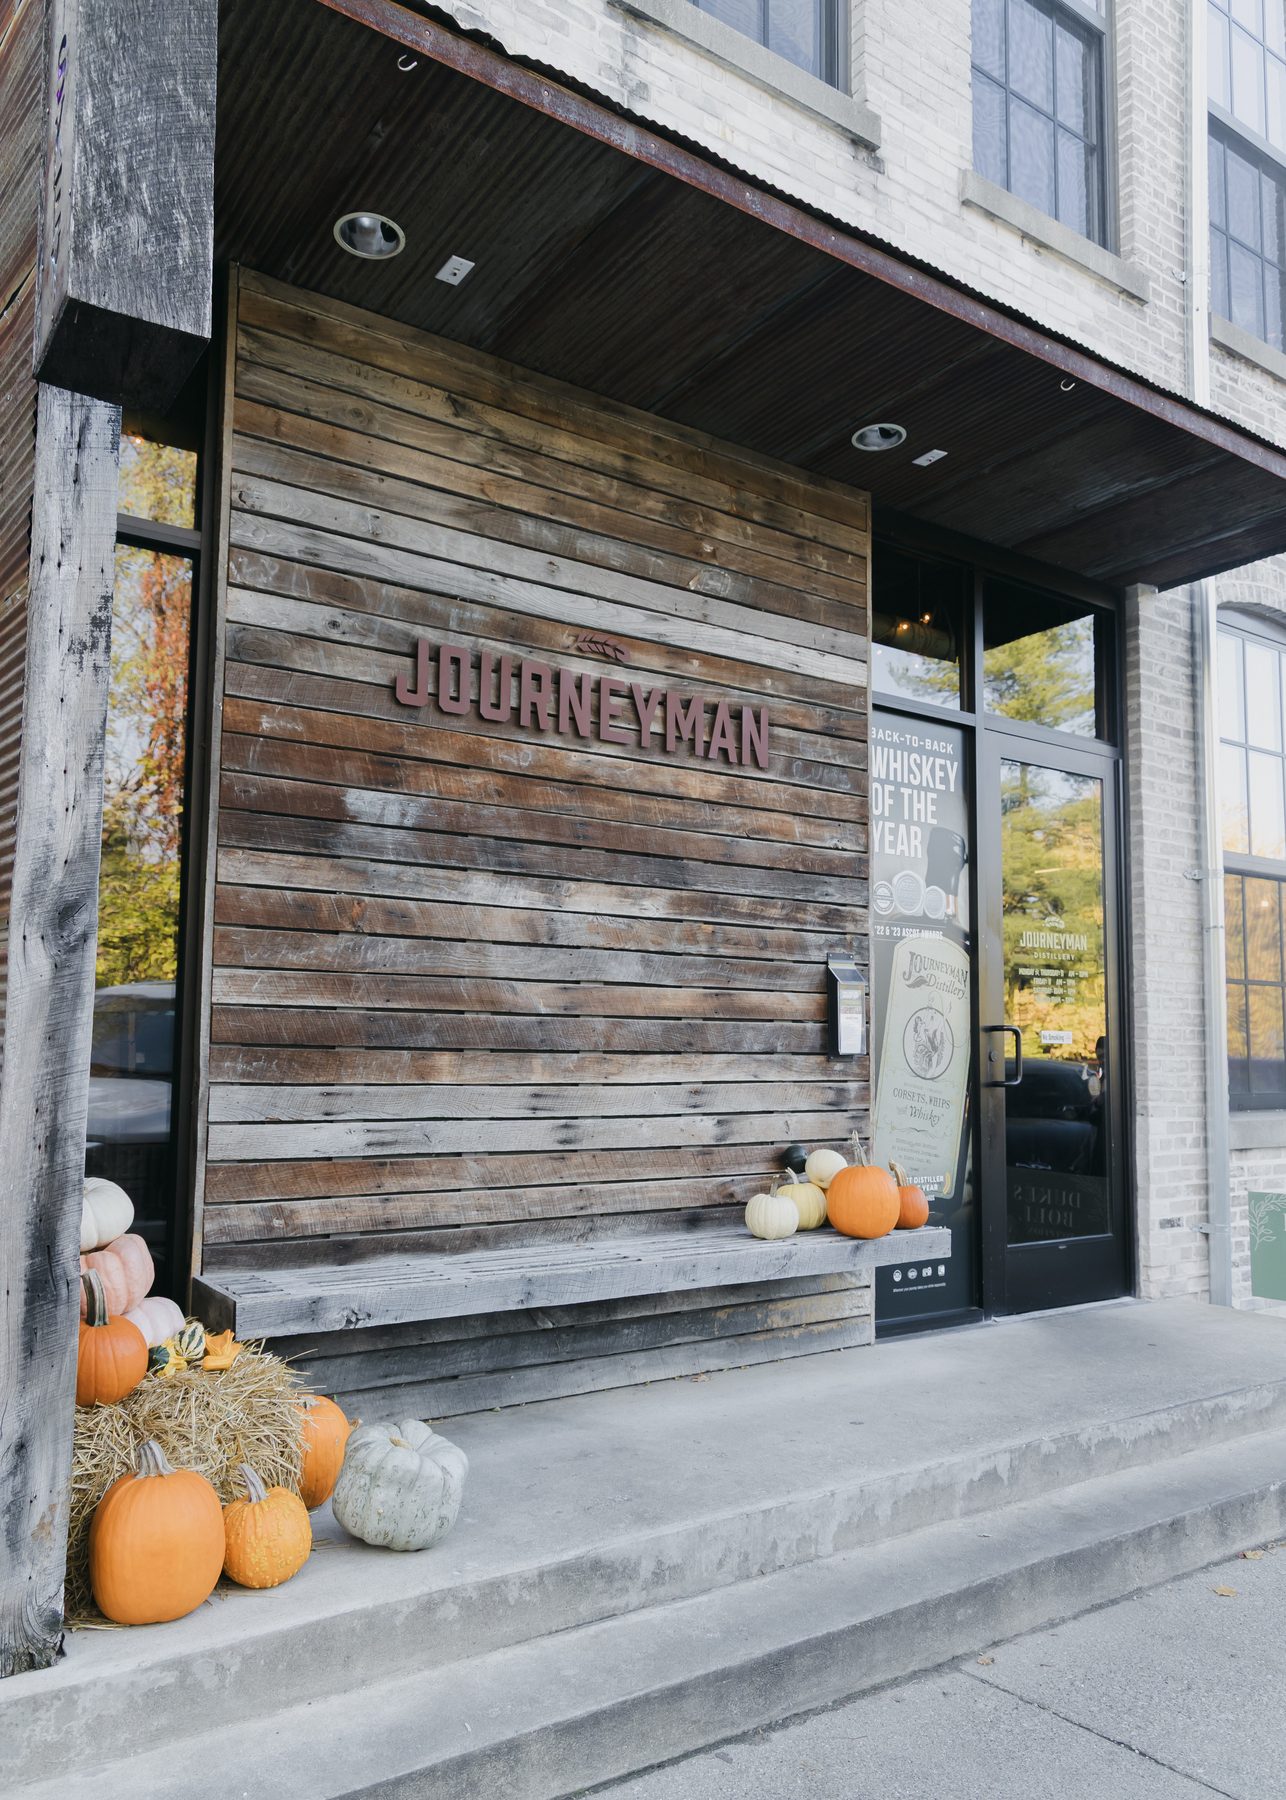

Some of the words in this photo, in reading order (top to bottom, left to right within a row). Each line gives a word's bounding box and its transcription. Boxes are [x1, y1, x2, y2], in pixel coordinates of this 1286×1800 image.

[395, 638, 769, 768] JOURNEYMAN
[871, 727, 954, 755] BACK-TO-BACK
[871, 745, 959, 793] WHISKEY
[872, 782, 895, 817] OF
[900, 787, 938, 825] THE
[872, 821, 922, 859] YEAR
[1020, 931, 1088, 950] JOURNEYMAN
[1034, 952, 1076, 961] DISTILLERY
[903, 951, 969, 988] JOURNEYMAN
[926, 973, 967, 1000] Distillery
[1048, 1033, 1065, 1042] Smoking
[928, 1095, 951, 1110] WHIPS
[909, 1105, 941, 1127] Whiskey
[914, 1176, 944, 1184] DISTILLER
[922, 1184, 938, 1192] YEAR
